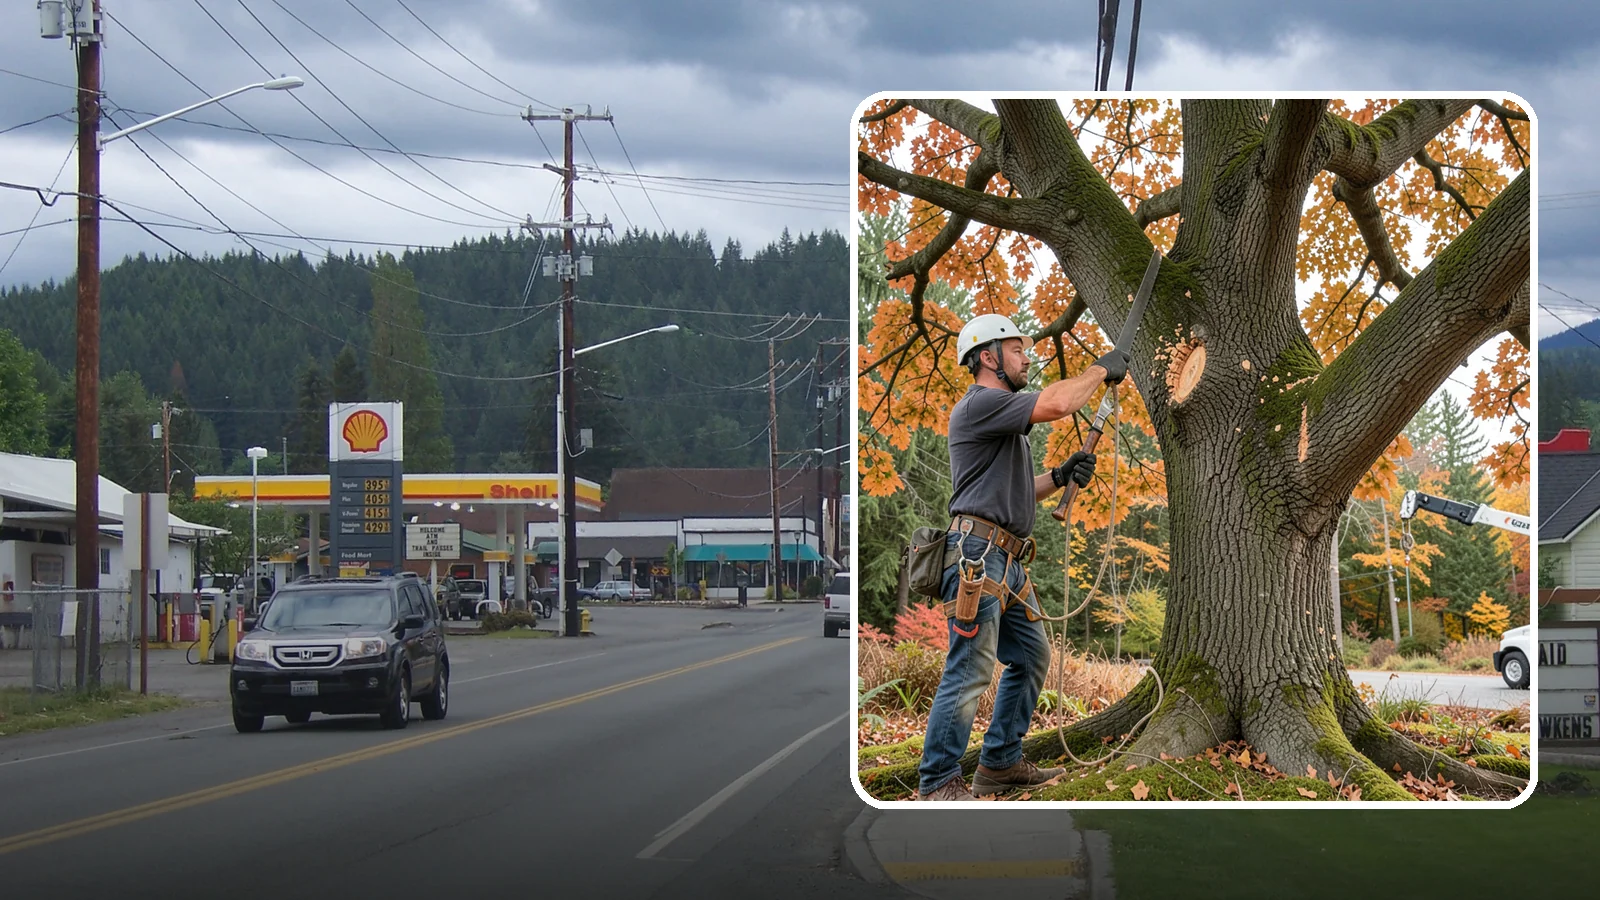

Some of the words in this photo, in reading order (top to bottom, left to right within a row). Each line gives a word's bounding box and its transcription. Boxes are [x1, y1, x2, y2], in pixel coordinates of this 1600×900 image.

[365, 480, 384, 490] 395
[489, 484, 547, 499] Shell
[365, 494, 384, 504] 405
[365, 508, 384, 518] 415
[365, 522, 384, 532] 429
